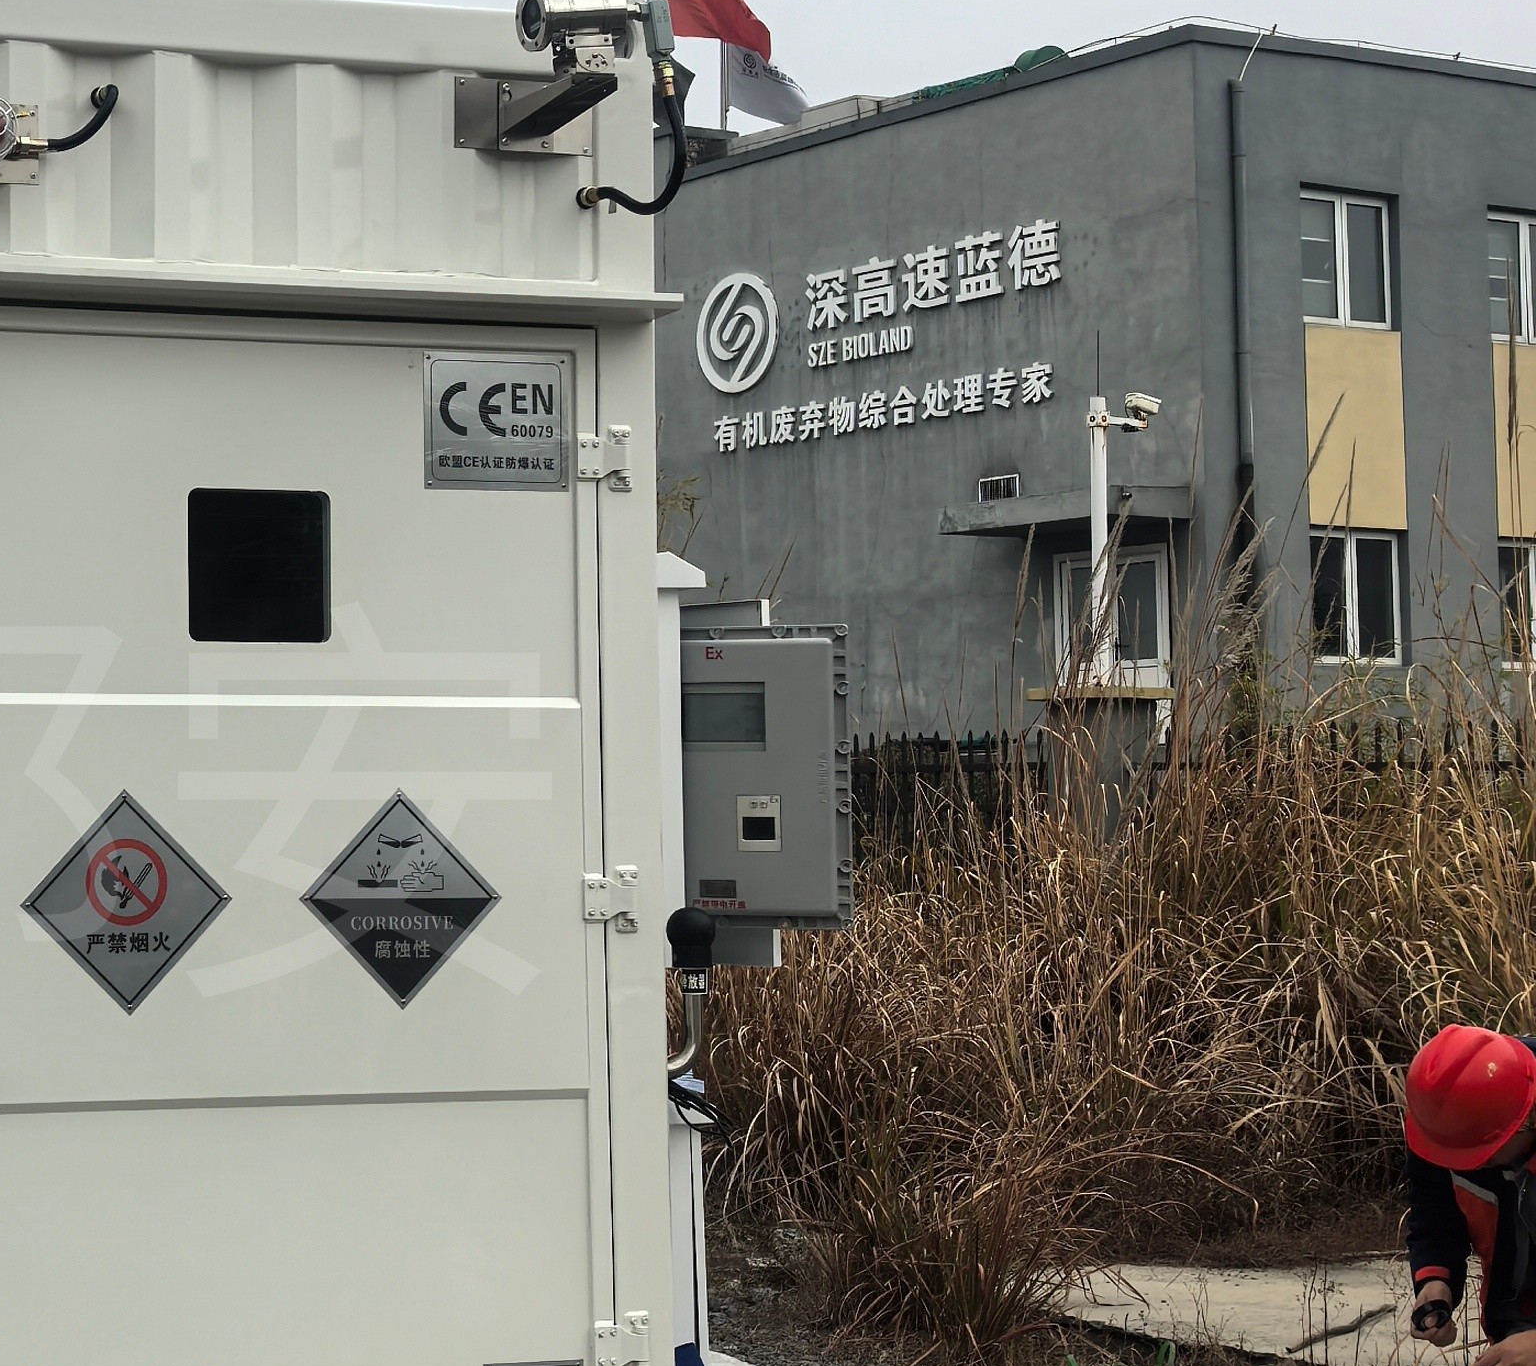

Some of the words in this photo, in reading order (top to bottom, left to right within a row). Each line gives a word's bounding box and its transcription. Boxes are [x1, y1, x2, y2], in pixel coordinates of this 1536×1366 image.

[805, 218, 1062, 332] 深高速蓝德
[807, 338, 838, 369] SZE
[841, 325, 914, 363] BIOLAND
[439, 381, 507, 438] CE
[511, 383, 553, 416] EN
[713, 361, 1055, 454] 有机废弃物综合处理专家
[511, 424, 554, 439] 60079
[438, 455, 555, 471] 欧盟CE认证防爆认证
[705, 646, 724, 660] Ex
[350, 914, 454, 931] CORROSIVE
[85, 931, 171, 955] 严禁烟火
[374, 939, 431, 960] 腐蚀性
